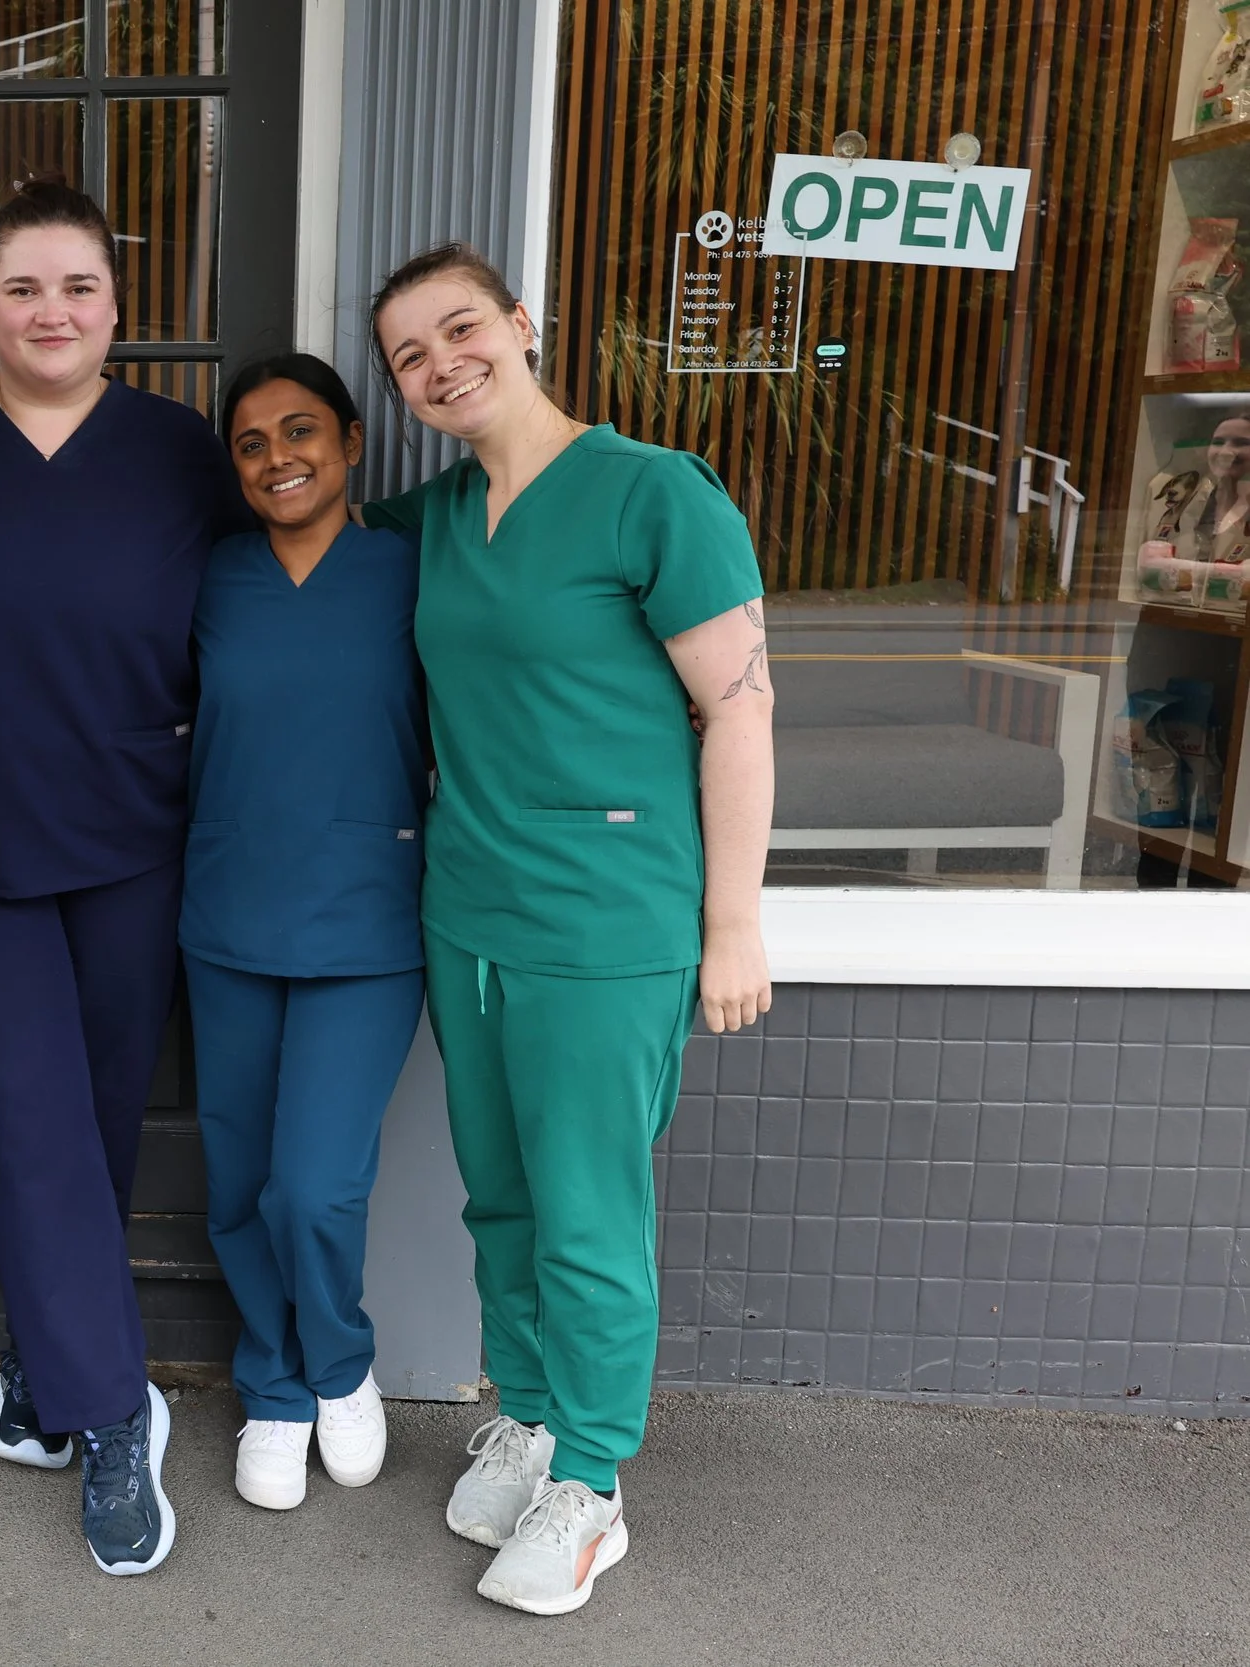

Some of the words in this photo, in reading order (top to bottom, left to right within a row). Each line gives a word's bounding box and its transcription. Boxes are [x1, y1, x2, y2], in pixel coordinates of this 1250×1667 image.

[782, 171, 1015, 252] OPEN
[738, 216, 790, 229] kelbn
[736, 230, 765, 242] vets
[706, 251, 721, 259] Ph:
[722, 251, 733, 259] 04
[735, 251, 751, 259] 475
[684, 272, 722, 282] Monday
[775, 271, 780, 280] 8
[789, 271, 794, 280] 7
[683, 287, 720, 296] Tuesday
[774, 286, 779, 294] 8
[787, 286, 793, 294] 7
[682, 301, 736, 311] Wednesday
[773, 301, 778, 309] 8
[786, 301, 791, 309] 7
[681, 316, 720, 325] Thursday
[771, 316, 777, 324] 8
[785, 316, 790, 324] 7
[680, 330, 707, 340] Friday
[770, 330, 775, 338] 8
[783, 330, 789, 338] 7
[678, 345, 718, 355] Saturday
[769, 345, 774, 353] 9
[781, 345, 787, 353] 4
